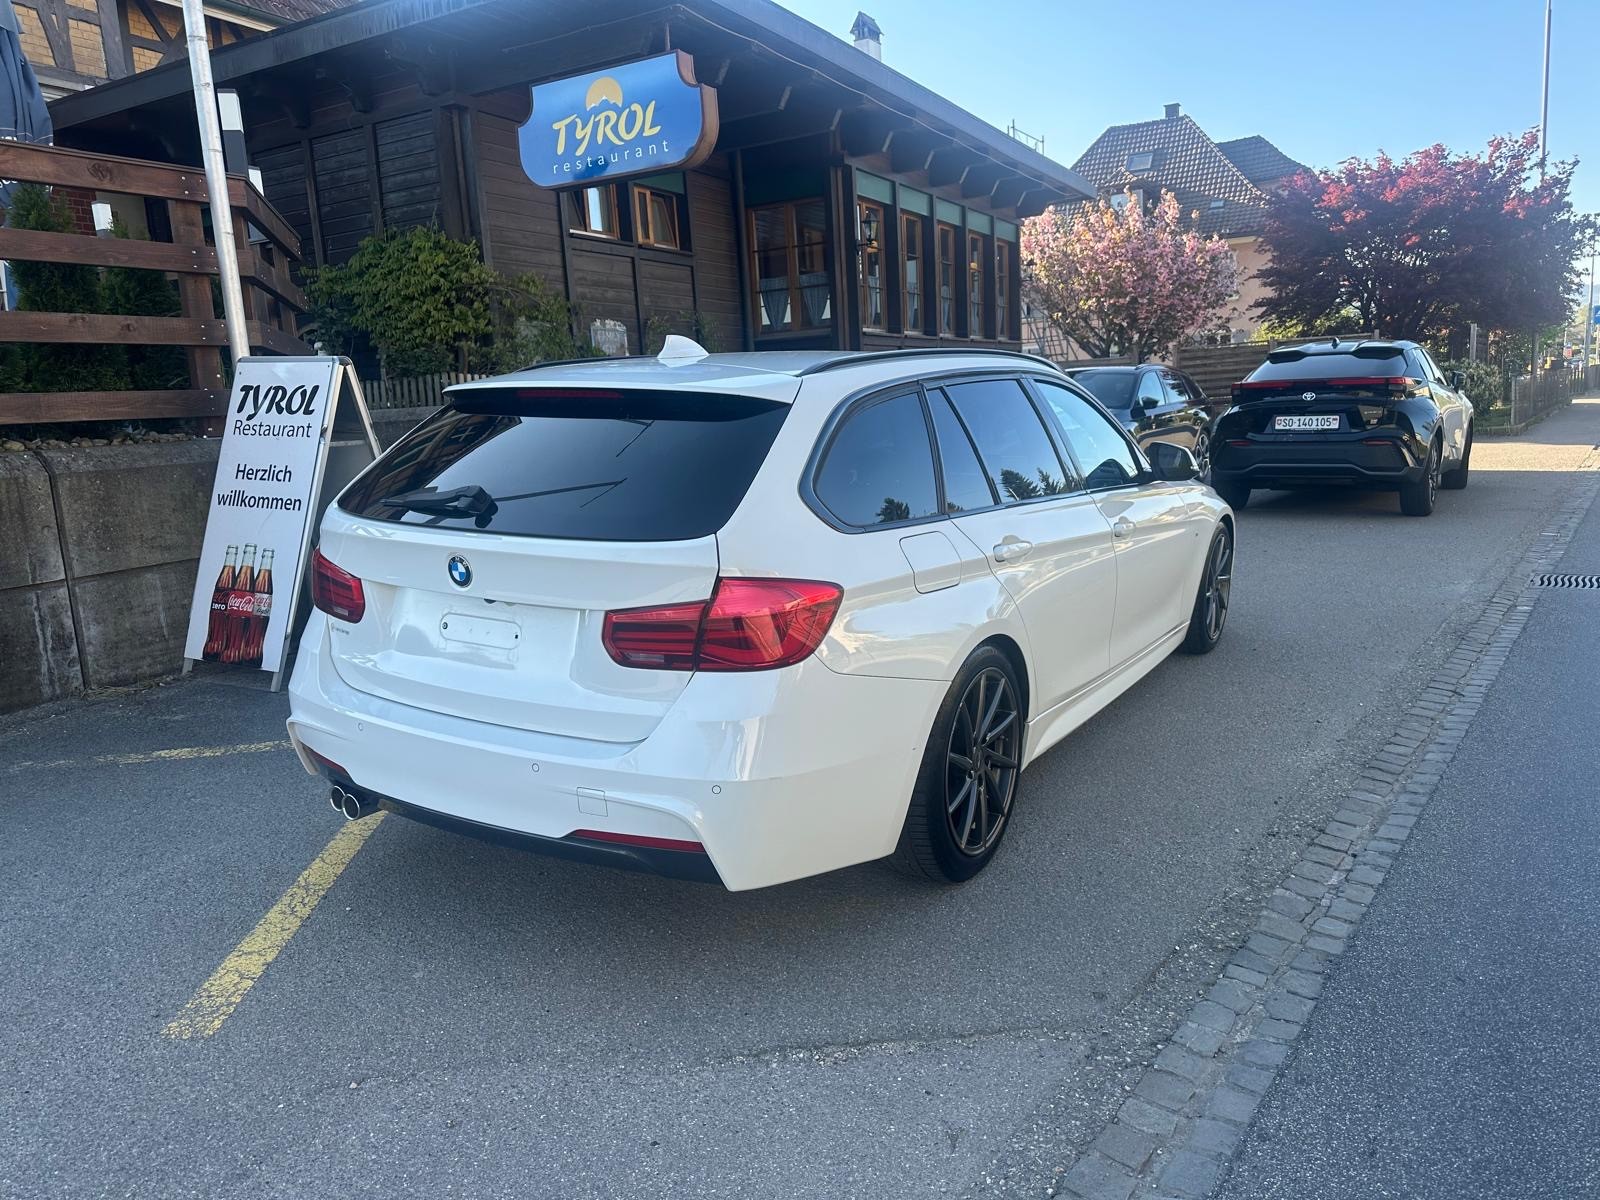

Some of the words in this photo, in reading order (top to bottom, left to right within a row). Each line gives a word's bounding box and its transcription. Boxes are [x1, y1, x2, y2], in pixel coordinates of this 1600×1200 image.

[552, 100, 662, 156] TYROL
[553, 139, 670, 174] restaurant
[237, 384, 320, 421] TYROL
[233, 419, 312, 438] Restaurant
[235, 463, 292, 482] Herzlich
[217, 489, 302, 511] willkommen
